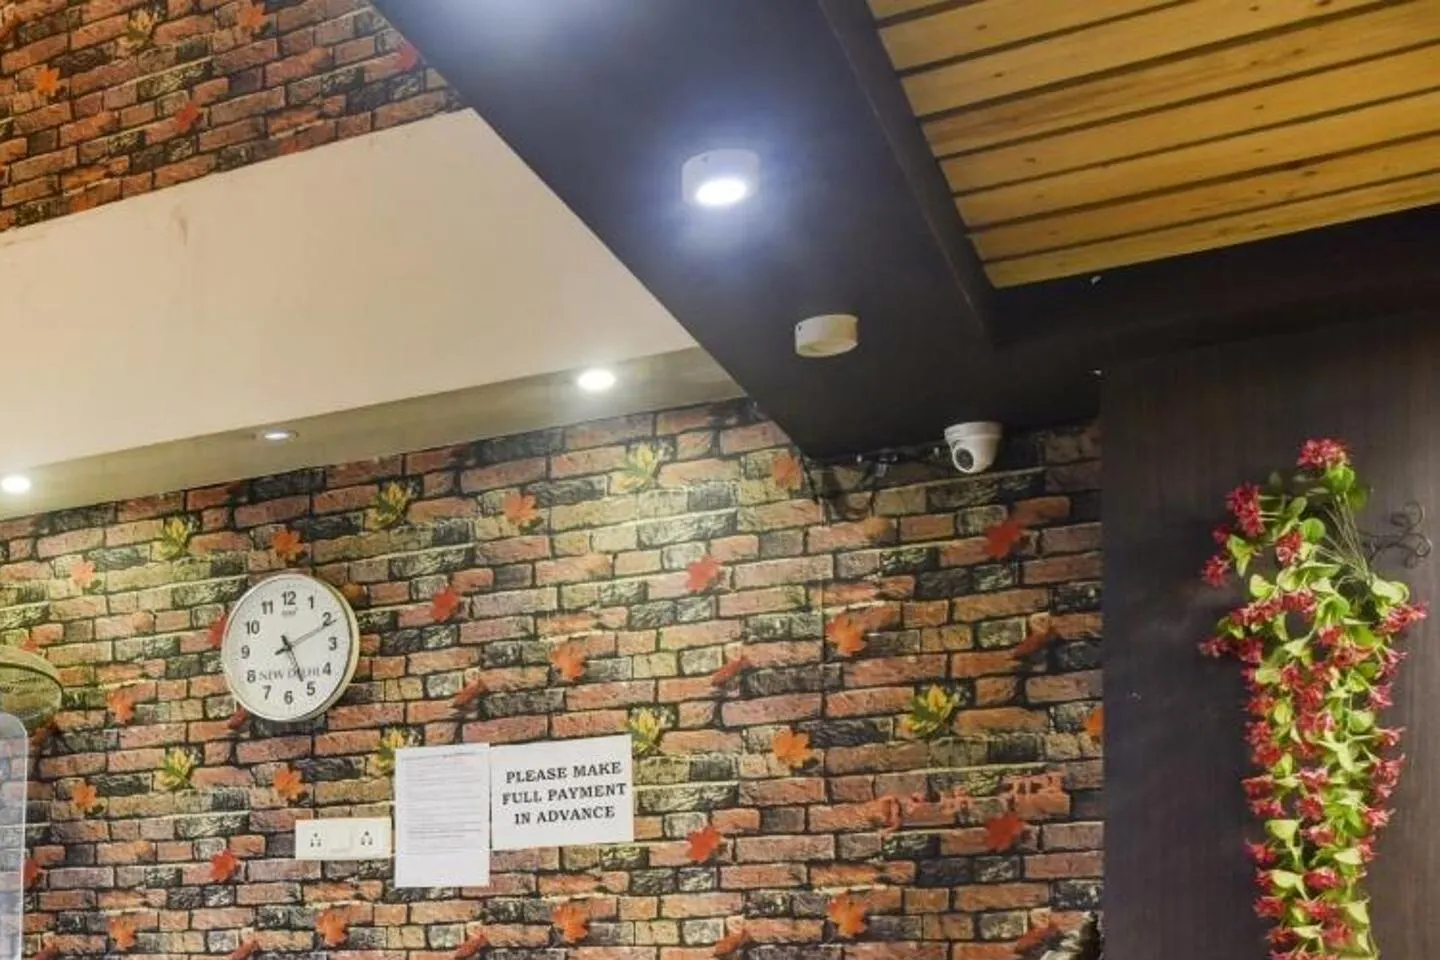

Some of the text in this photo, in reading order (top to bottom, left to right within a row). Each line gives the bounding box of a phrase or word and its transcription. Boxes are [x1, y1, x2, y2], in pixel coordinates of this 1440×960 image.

[281, 591, 297, 606] 12
[308, 595, 314, 609] 1
[262, 600, 274, 615] 11
[322, 612, 332, 627] 2
[246, 620, 260, 635] 10
[328, 637, 337, 651] 3
[241, 645, 250, 659] 9
[247, 670, 256, 683] 8
[322, 662, 331, 676] 4
[262, 685, 272, 700] 7
[307, 681, 316, 696] 5
[284, 690, 293, 704] 6
[506, 761, 623, 784] PLEASE MAKE
[502, 783, 628, 806] FULL PAYMENT
[514, 805, 616, 825] IN ADVANCE
